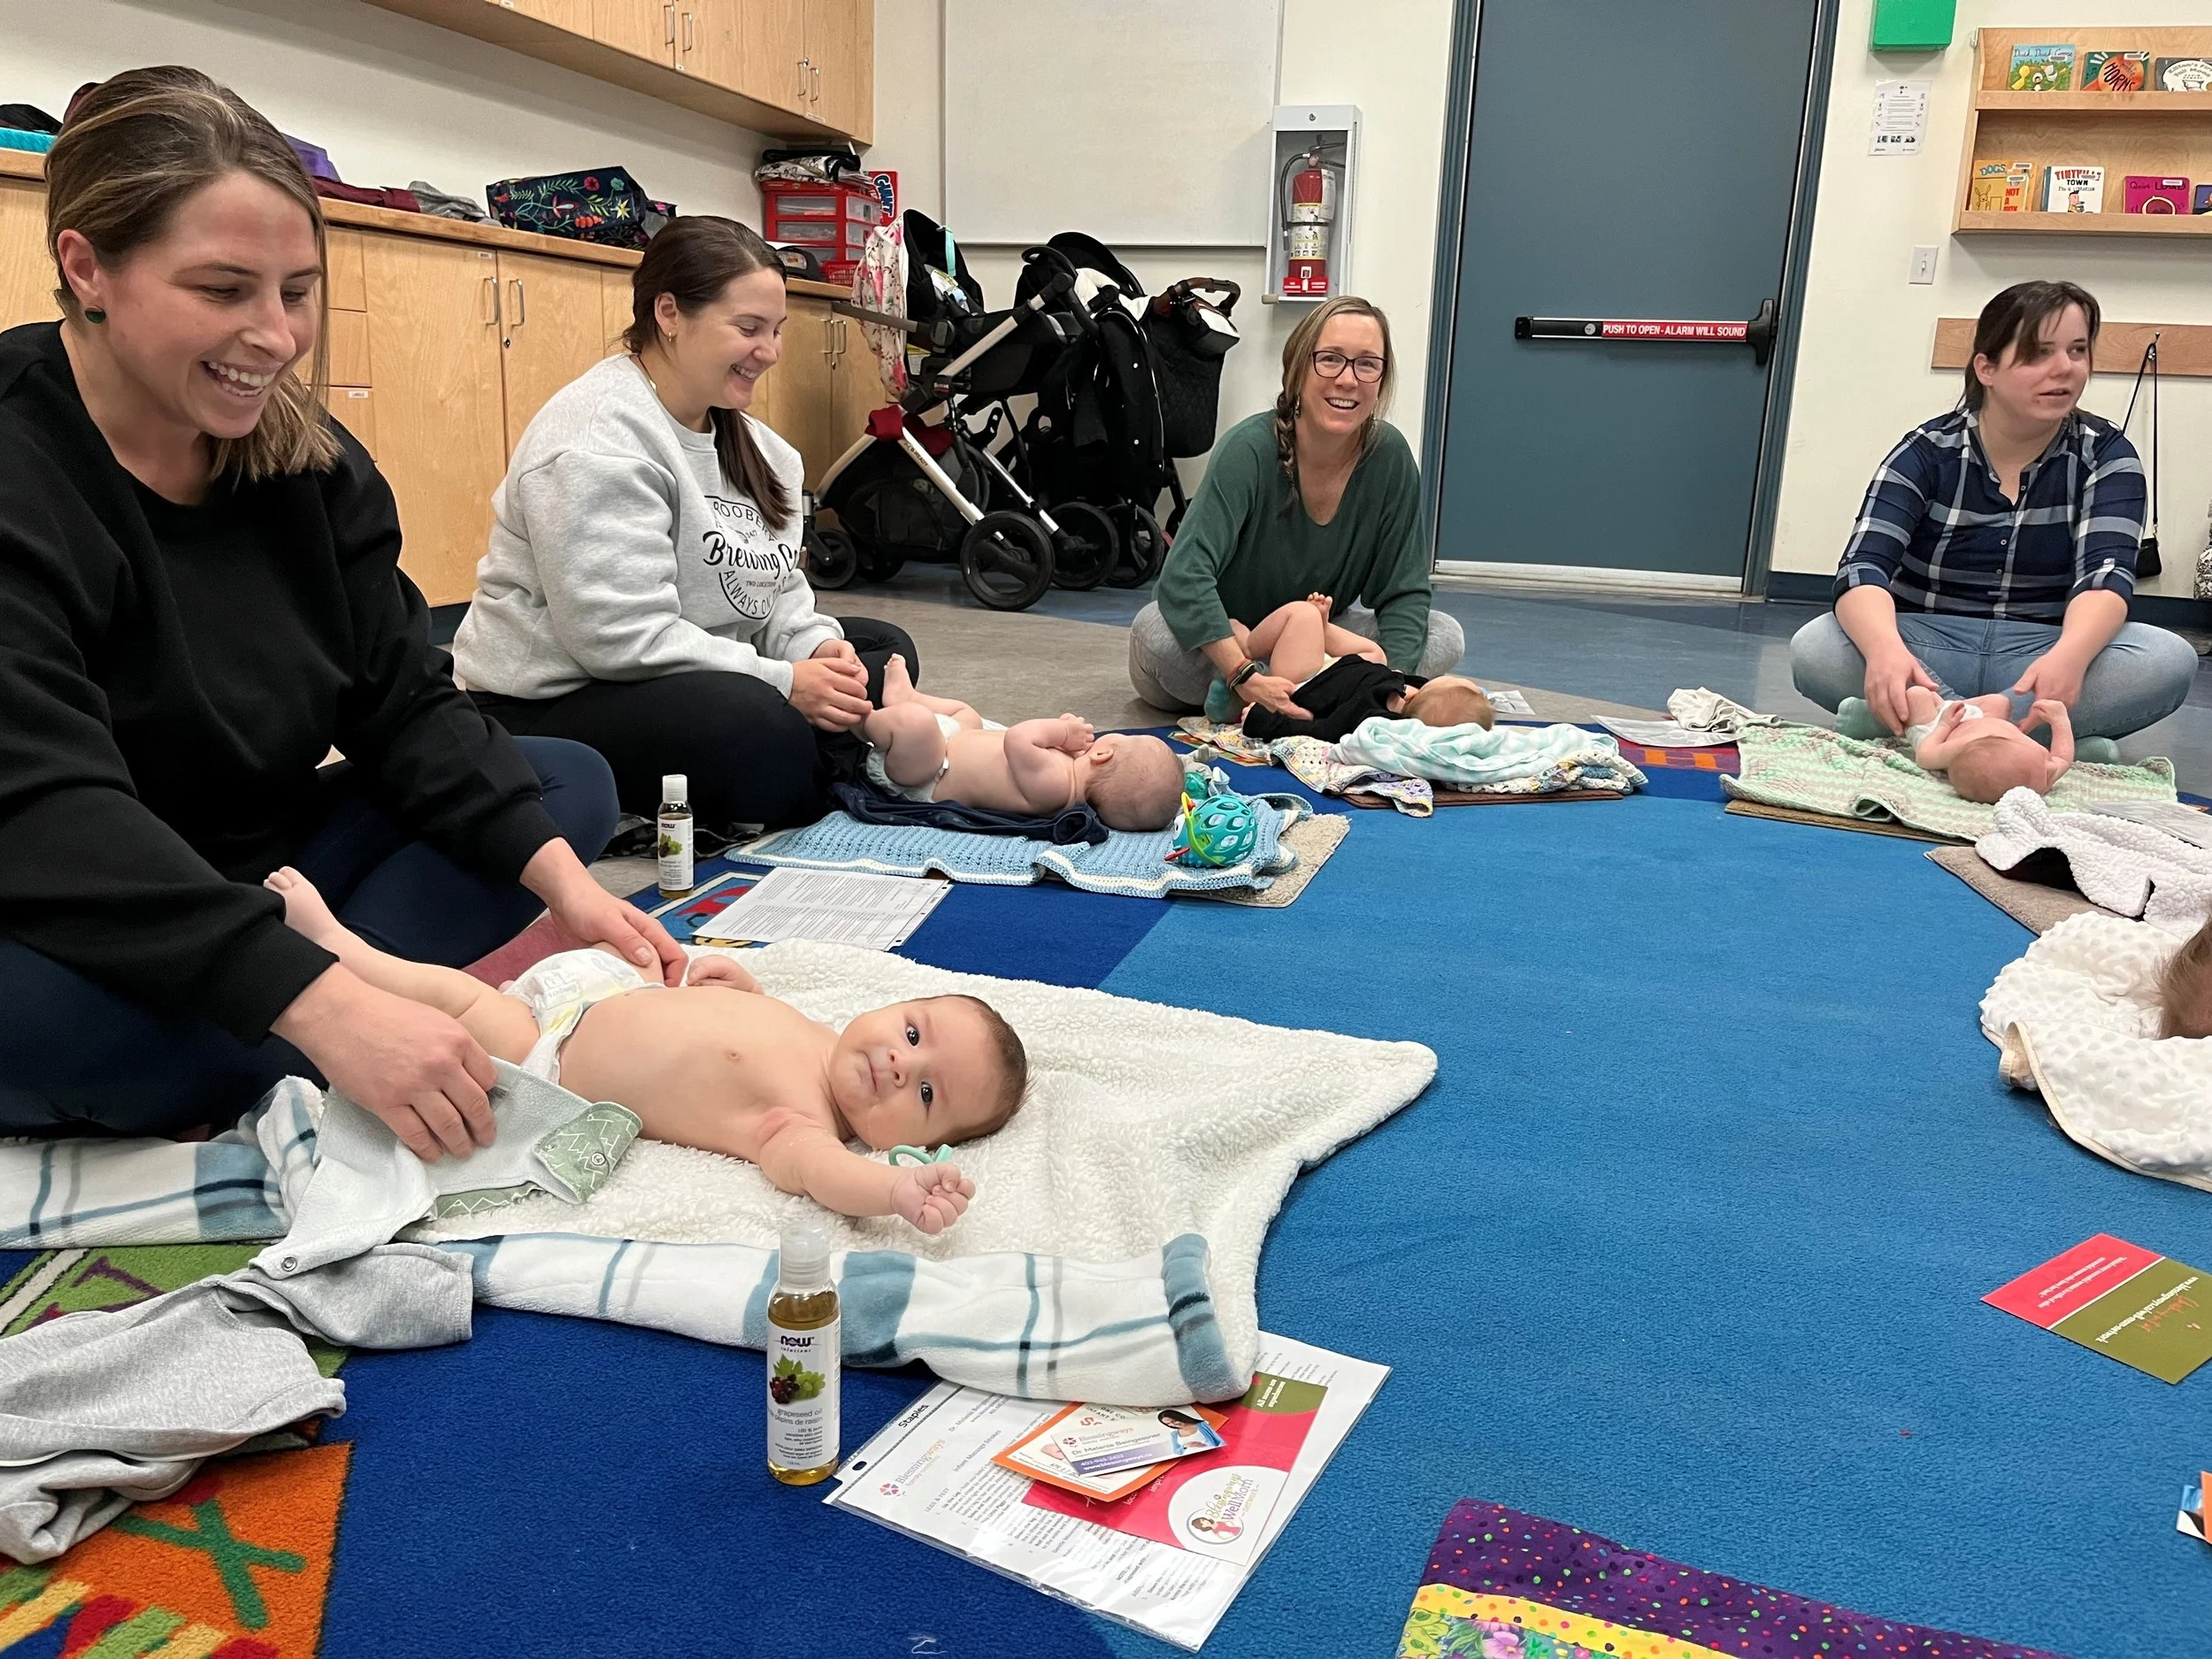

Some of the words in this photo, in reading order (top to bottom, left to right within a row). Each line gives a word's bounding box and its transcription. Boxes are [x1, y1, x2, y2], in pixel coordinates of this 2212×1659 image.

[2006, 188, 2020, 196] NOT
[1602, 325, 1624, 334] PUSH
[1625, 325, 1637, 334] TO
[1638, 325, 1660, 335] OPEN
[1664, 326, 1694, 336] ALARM
[1696, 327, 1715, 336] WILL
[1717, 327, 1746, 337] SOUND
[703, 531, 780, 580] Brewing
[723, 570, 758, 615] ALWAYS
[761, 595, 771, 615] ON
[1256, 1399, 1267, 1408] All
[778, 1408, 812, 1417] grapeseed
[898, 1404, 930, 1428] Staples
[1078, 1426, 1134, 1443] Blessingways
[1083, 1441, 1115, 1454] Melanie
[895, 1437, 946, 1484] Blessingways
[1205, 1472, 1244, 1518] Blessingways
